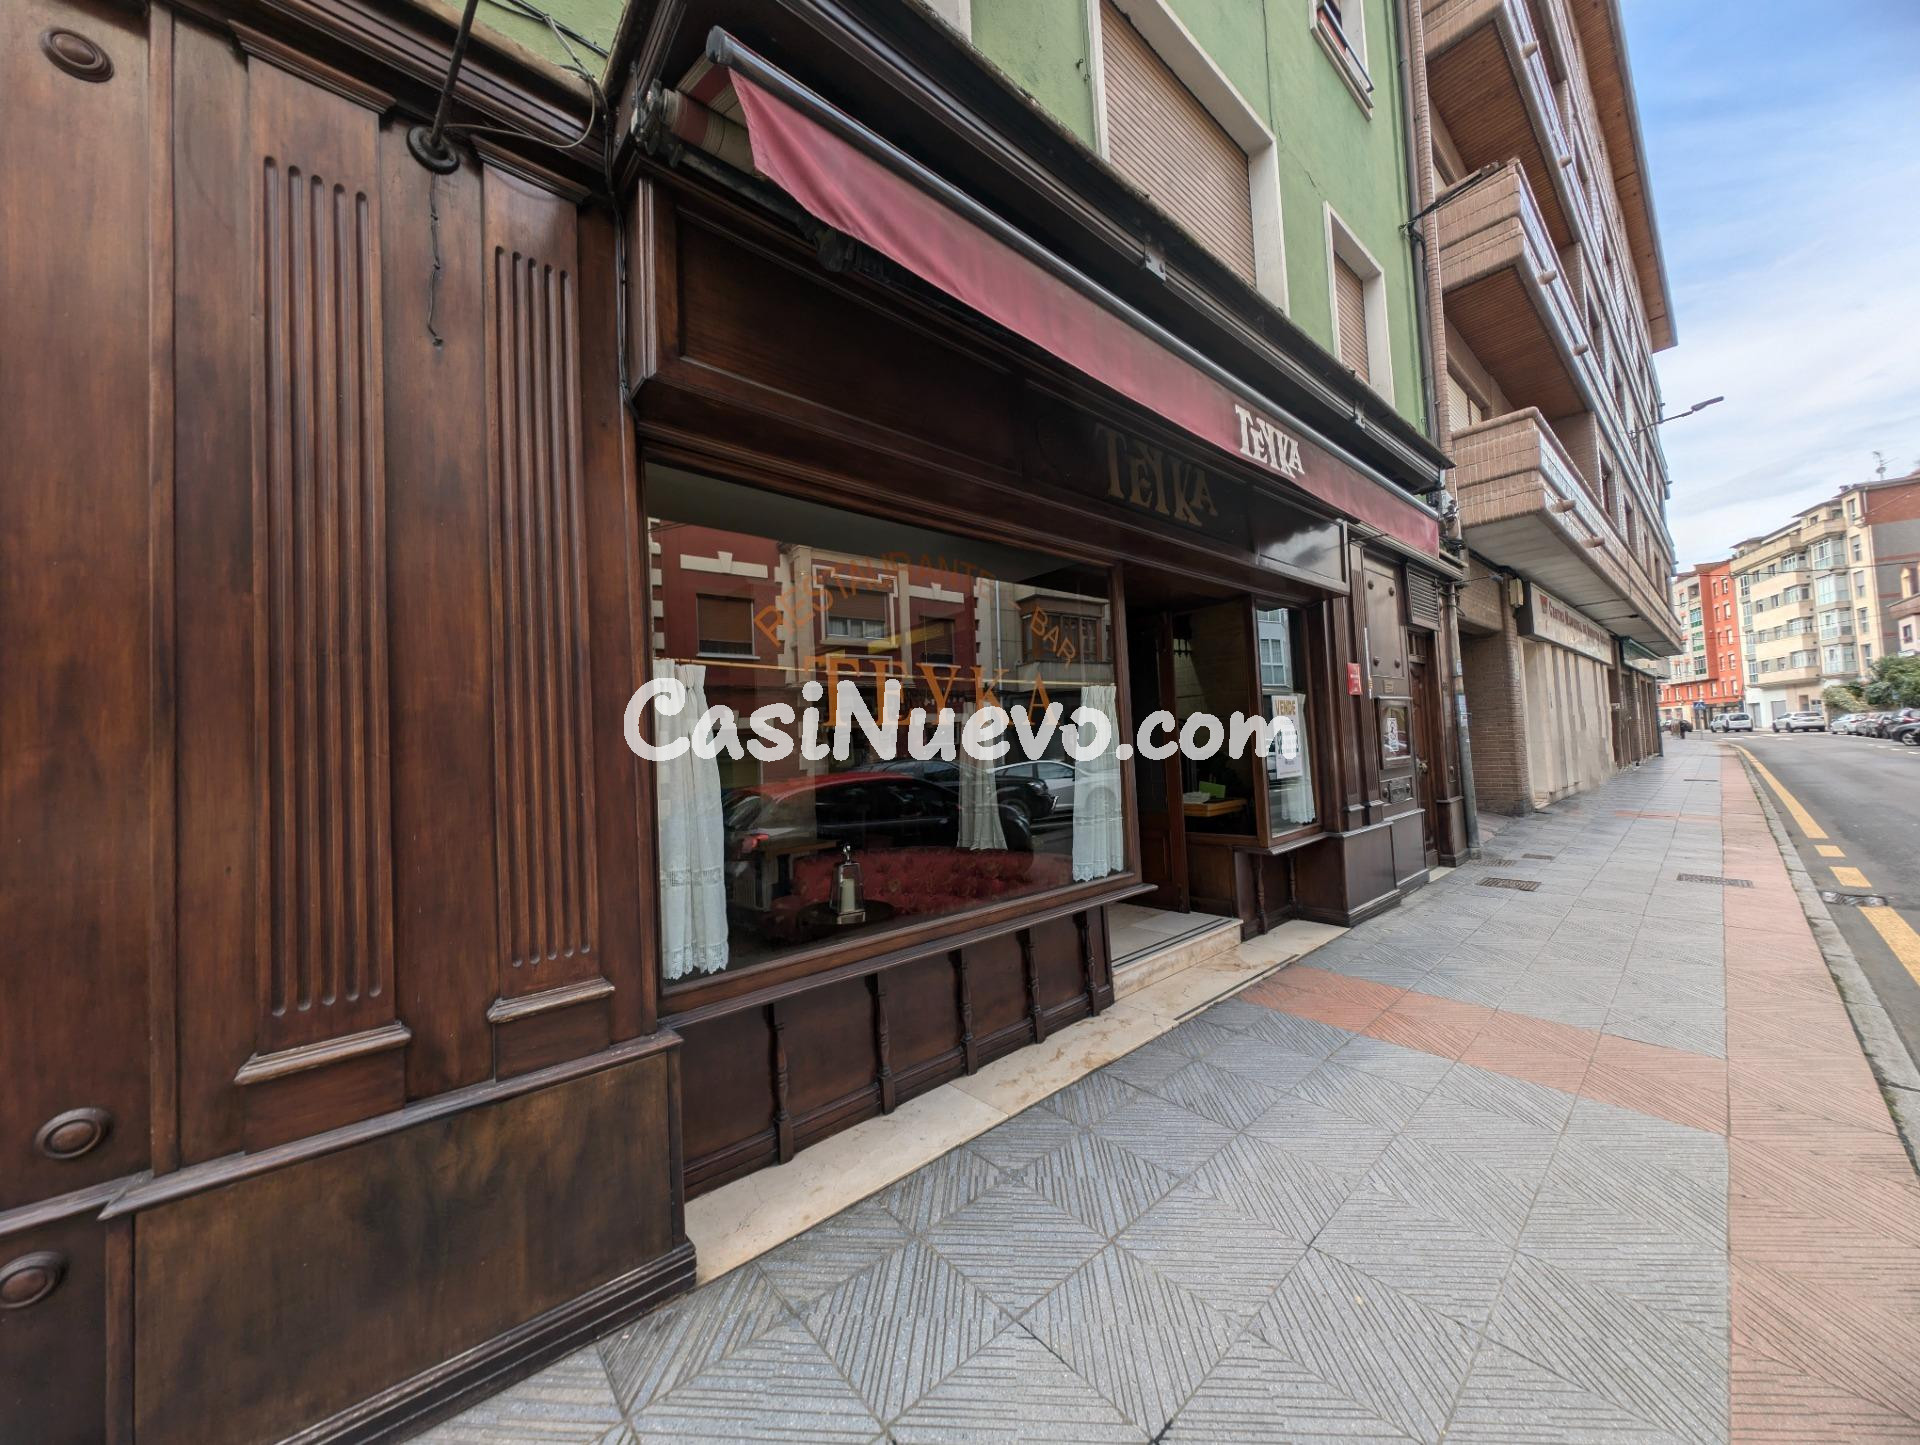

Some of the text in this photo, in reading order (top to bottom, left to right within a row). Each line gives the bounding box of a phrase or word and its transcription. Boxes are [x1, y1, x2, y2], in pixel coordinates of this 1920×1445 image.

[753, 550, 1076, 671] RESTAURANTE BAR
[804, 655, 1062, 727] TEYKA
[1276, 699, 1296, 716] VENDE
